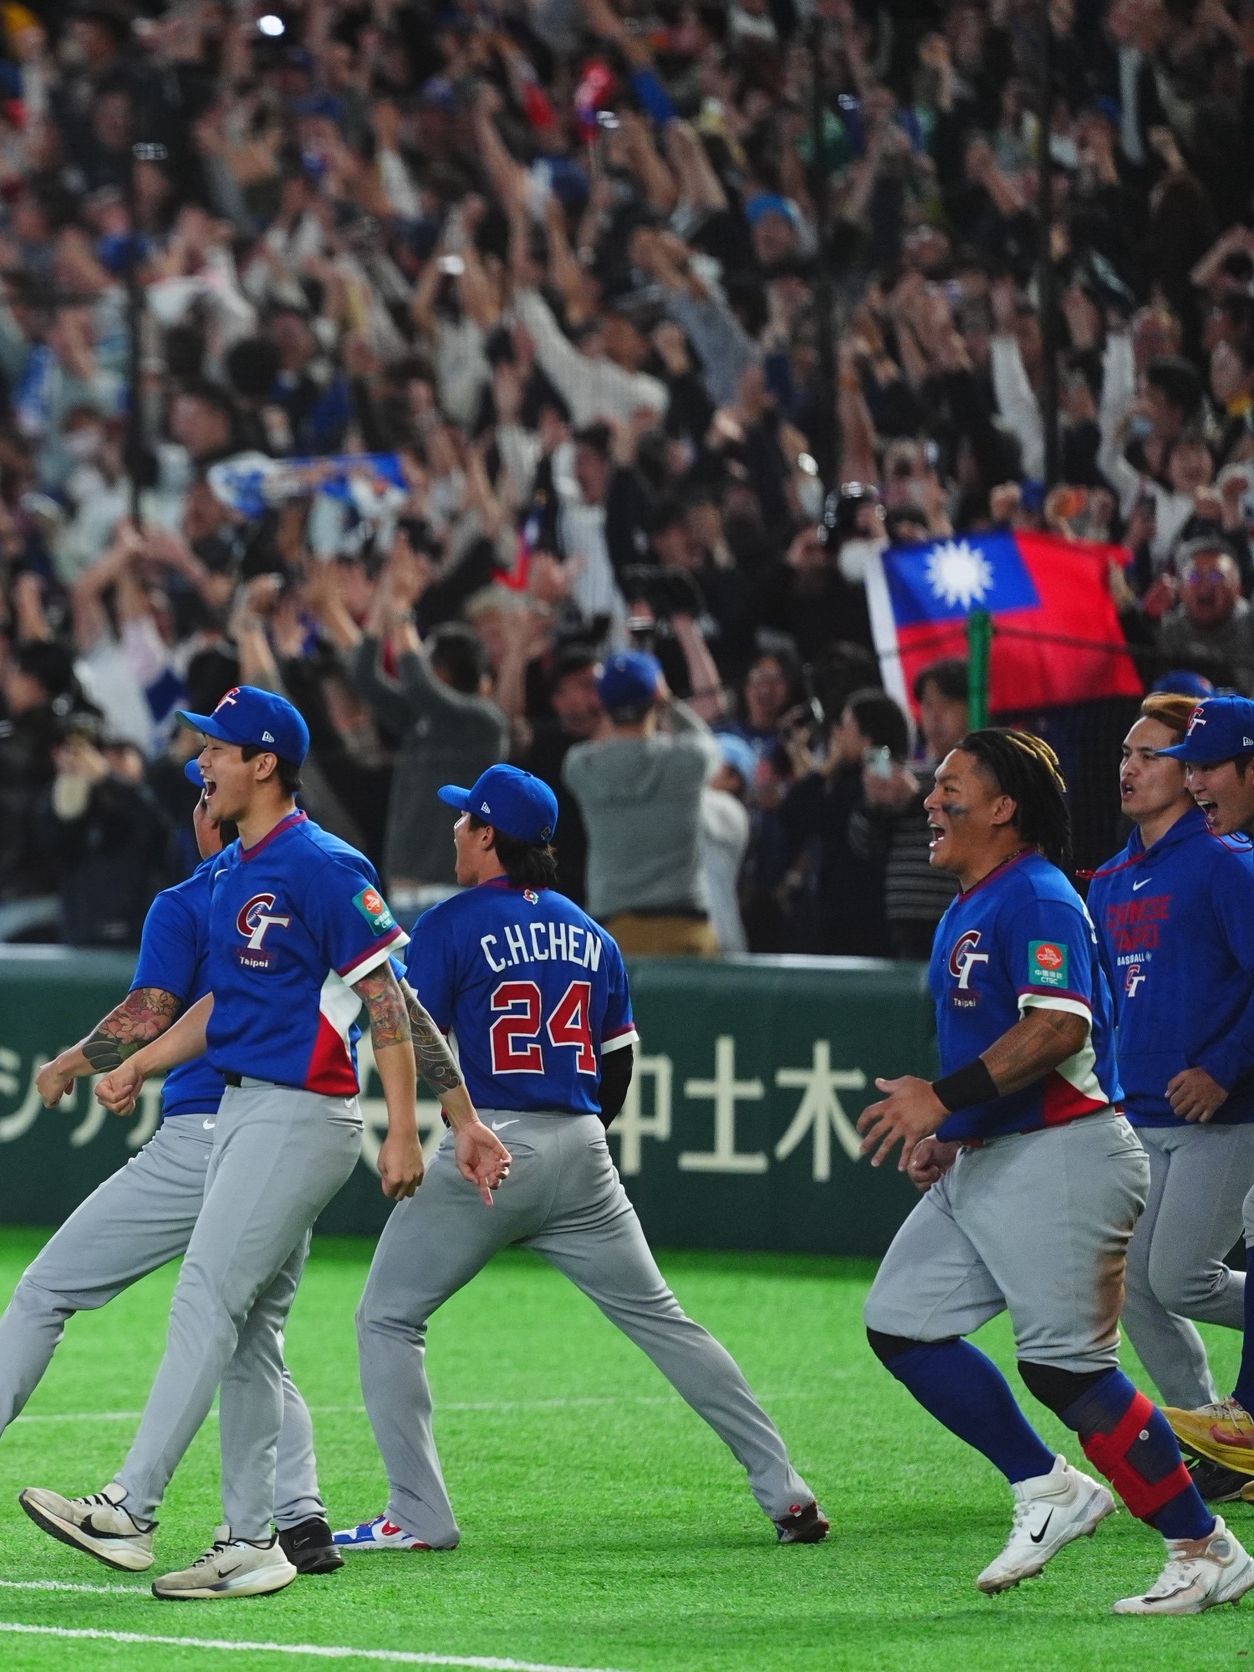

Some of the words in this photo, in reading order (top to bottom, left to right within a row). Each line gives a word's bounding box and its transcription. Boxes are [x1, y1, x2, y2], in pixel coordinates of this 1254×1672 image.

[239, 956, 269, 968] Taipei
[1117, 952, 1146, 967] BASBALL
[953, 997, 977, 1008] Taipei
[489, 980, 597, 1075] 24
